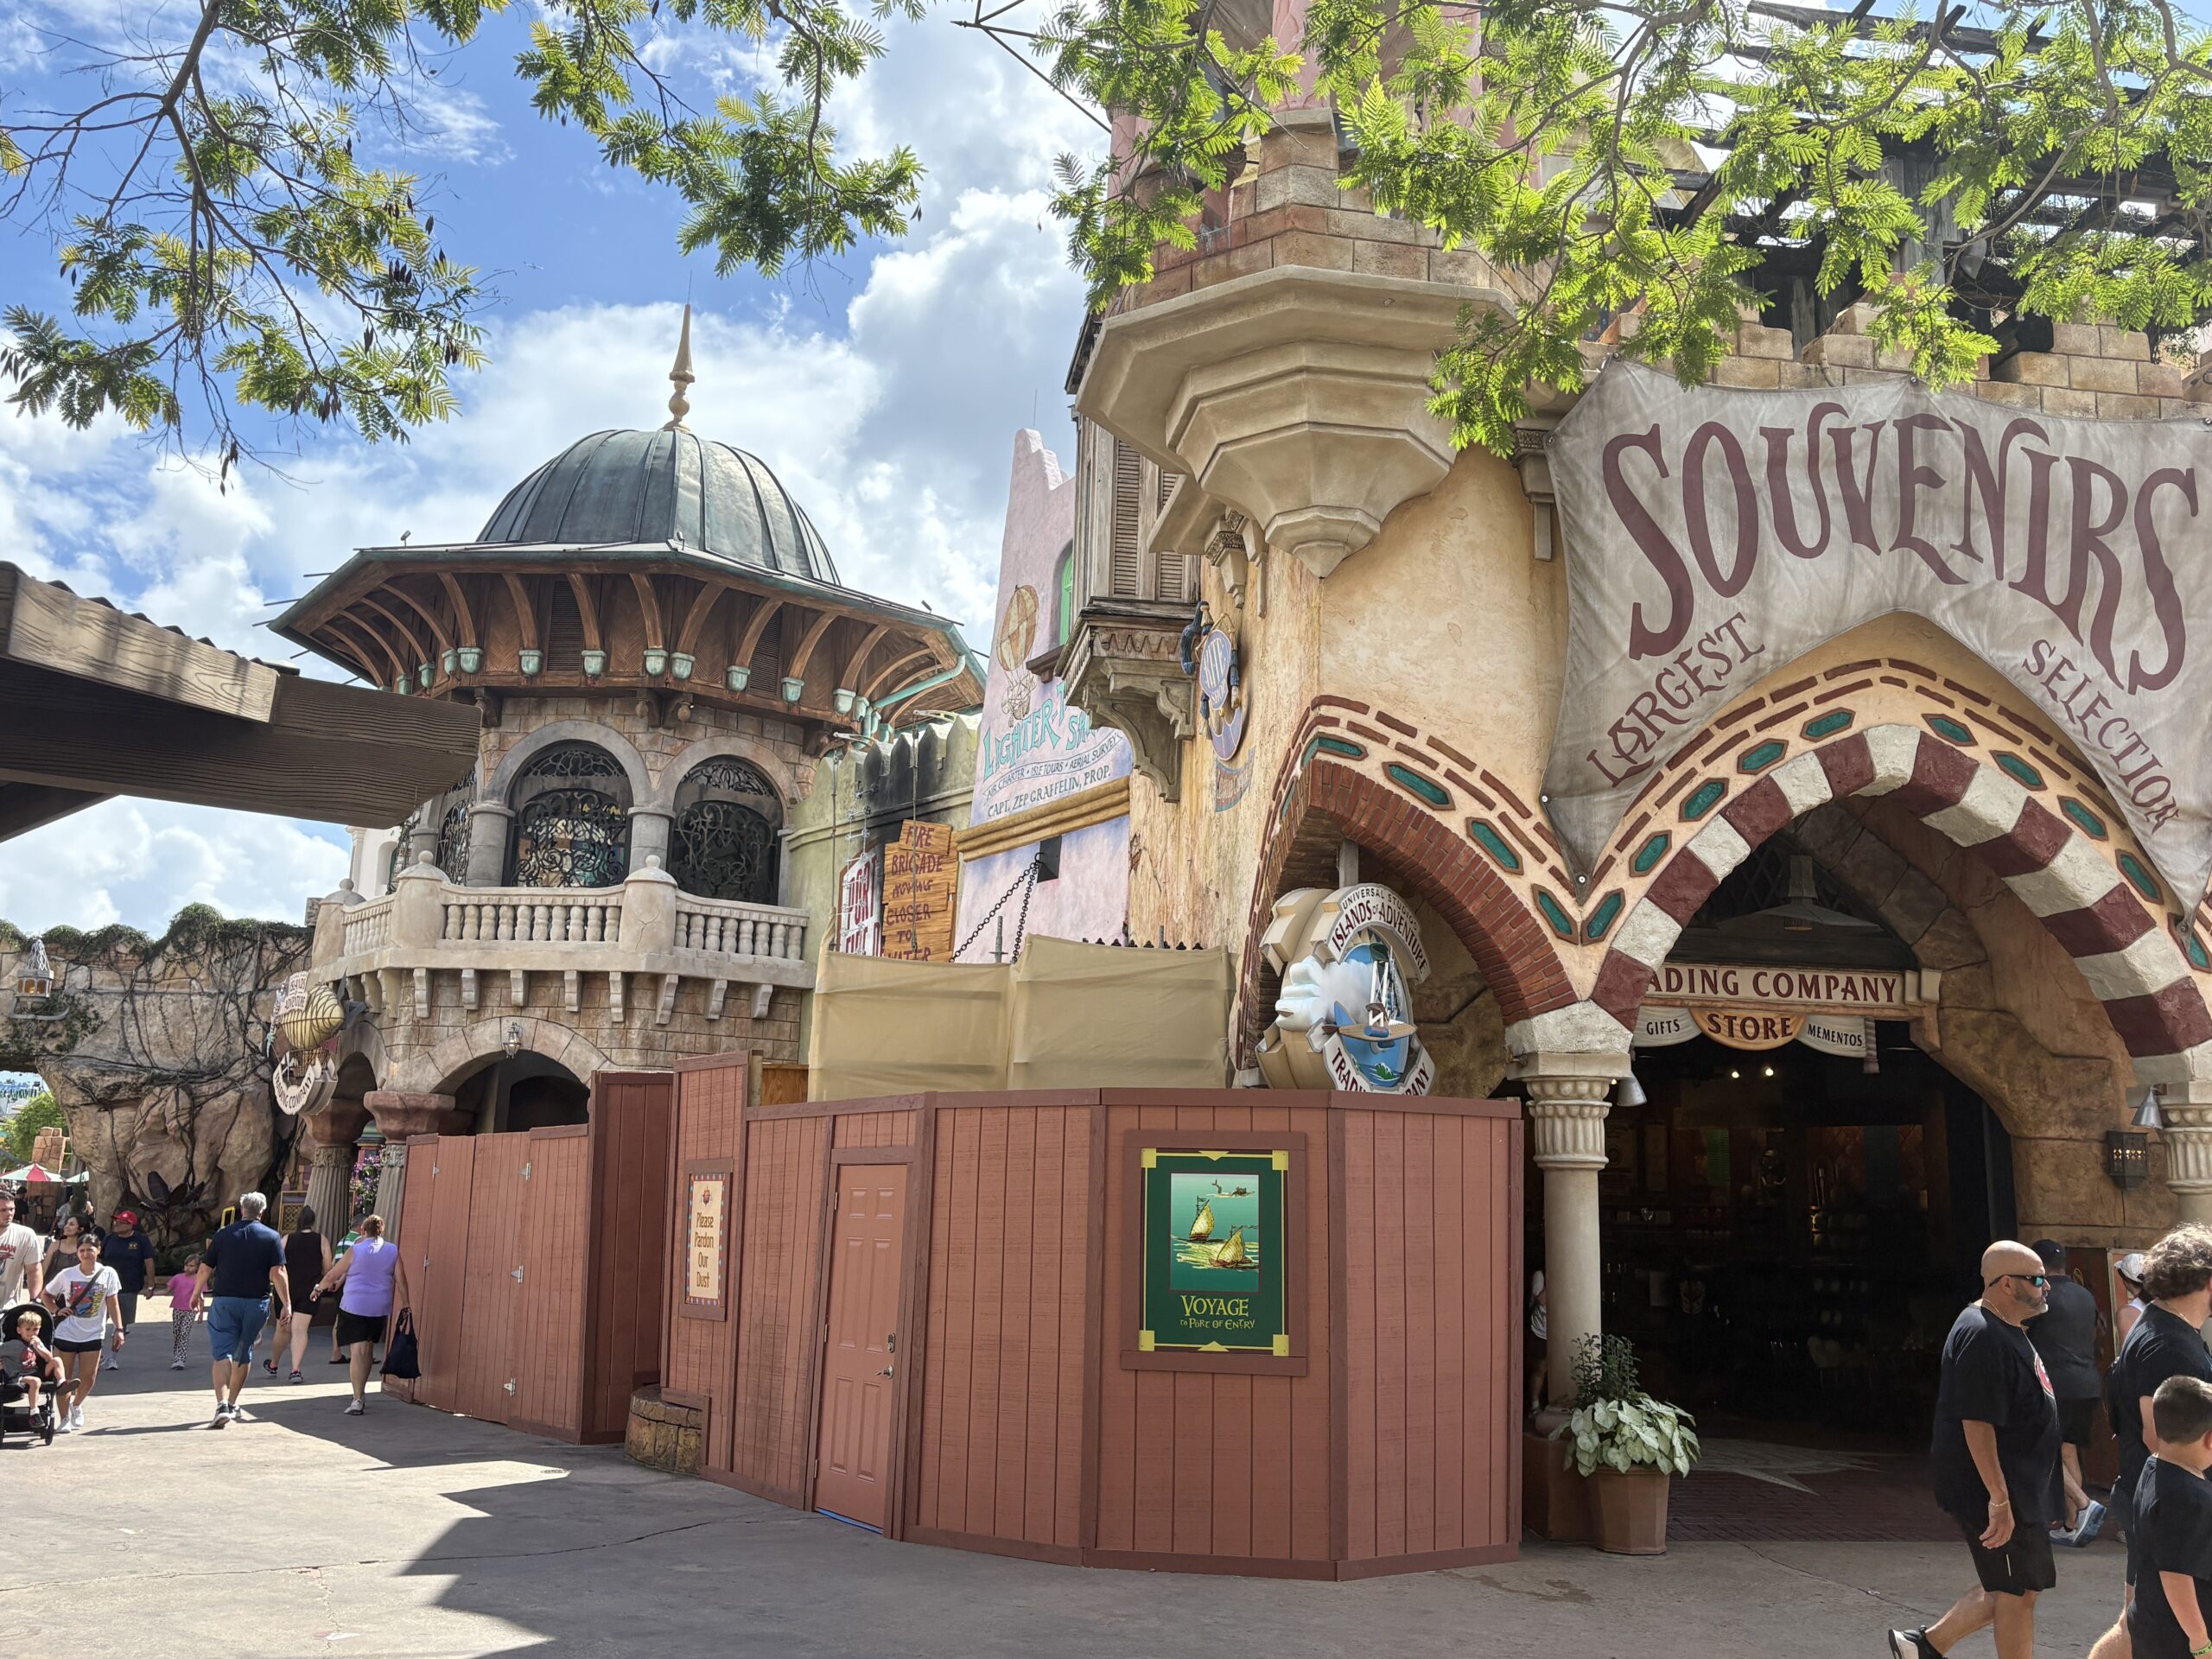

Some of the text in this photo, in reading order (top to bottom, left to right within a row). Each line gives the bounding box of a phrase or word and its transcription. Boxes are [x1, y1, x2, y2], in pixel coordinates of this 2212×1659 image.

[1602, 402, 2199, 696] SOUVENIRS
[1586, 611, 2181, 833] LARGEST SELECTION
[987, 734, 1117, 801] AIR CHARTER ISLE TOURS AERIAL SURVEY
[988, 765, 1111, 817] CAPT. ZEP GRAFFELIN, PROP.
[906, 825, 935, 849] FIRE
[891, 852, 944, 876] BRIGADE
[886, 903, 931, 926] CLOSER
[1342, 887, 1419, 931] UNIVERSAL STUDIOS
[897, 929, 912, 944] TO
[1332, 899, 1373, 952] ISLANDS
[1379, 901, 1428, 975] ADVENTURE
[1752, 970, 1897, 1003] COMPANY
[1646, 1019, 1681, 1035] GIFTS
[1707, 1013, 1794, 1041] STORE
[1807, 1023, 1863, 1047] MEMENTOS
[696, 1211, 714, 1229] Please
[694, 1231, 714, 1249] Pardon
[697, 1251, 709, 1268] Our
[696, 1271, 709, 1288] Dust
[1180, 1294, 1249, 1318] VOYAGE
